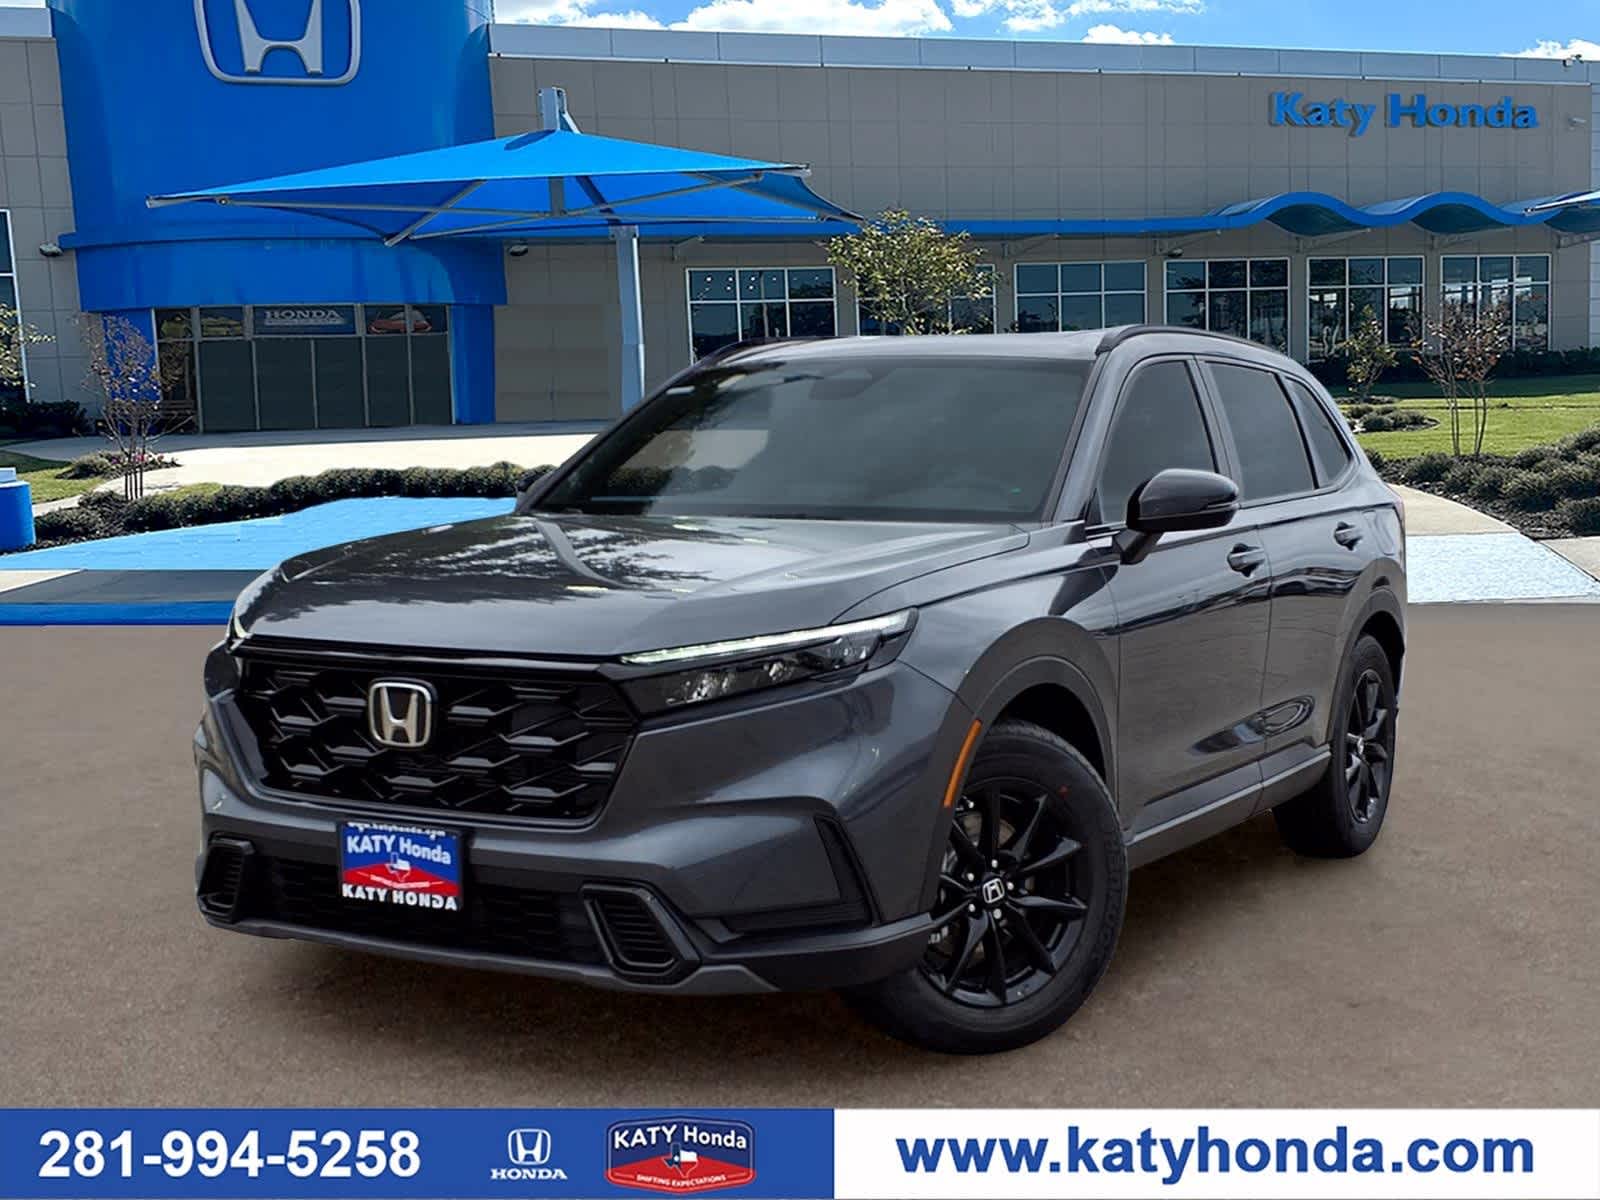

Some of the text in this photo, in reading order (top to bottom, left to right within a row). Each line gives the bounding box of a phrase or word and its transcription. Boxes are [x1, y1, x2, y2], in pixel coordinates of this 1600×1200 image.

[1270, 91, 1539, 137] Katy Honda
[265, 309, 343, 320] HONDA
[346, 835, 451, 864] KATY Honda
[342, 883, 457, 910] KATY HONDA
